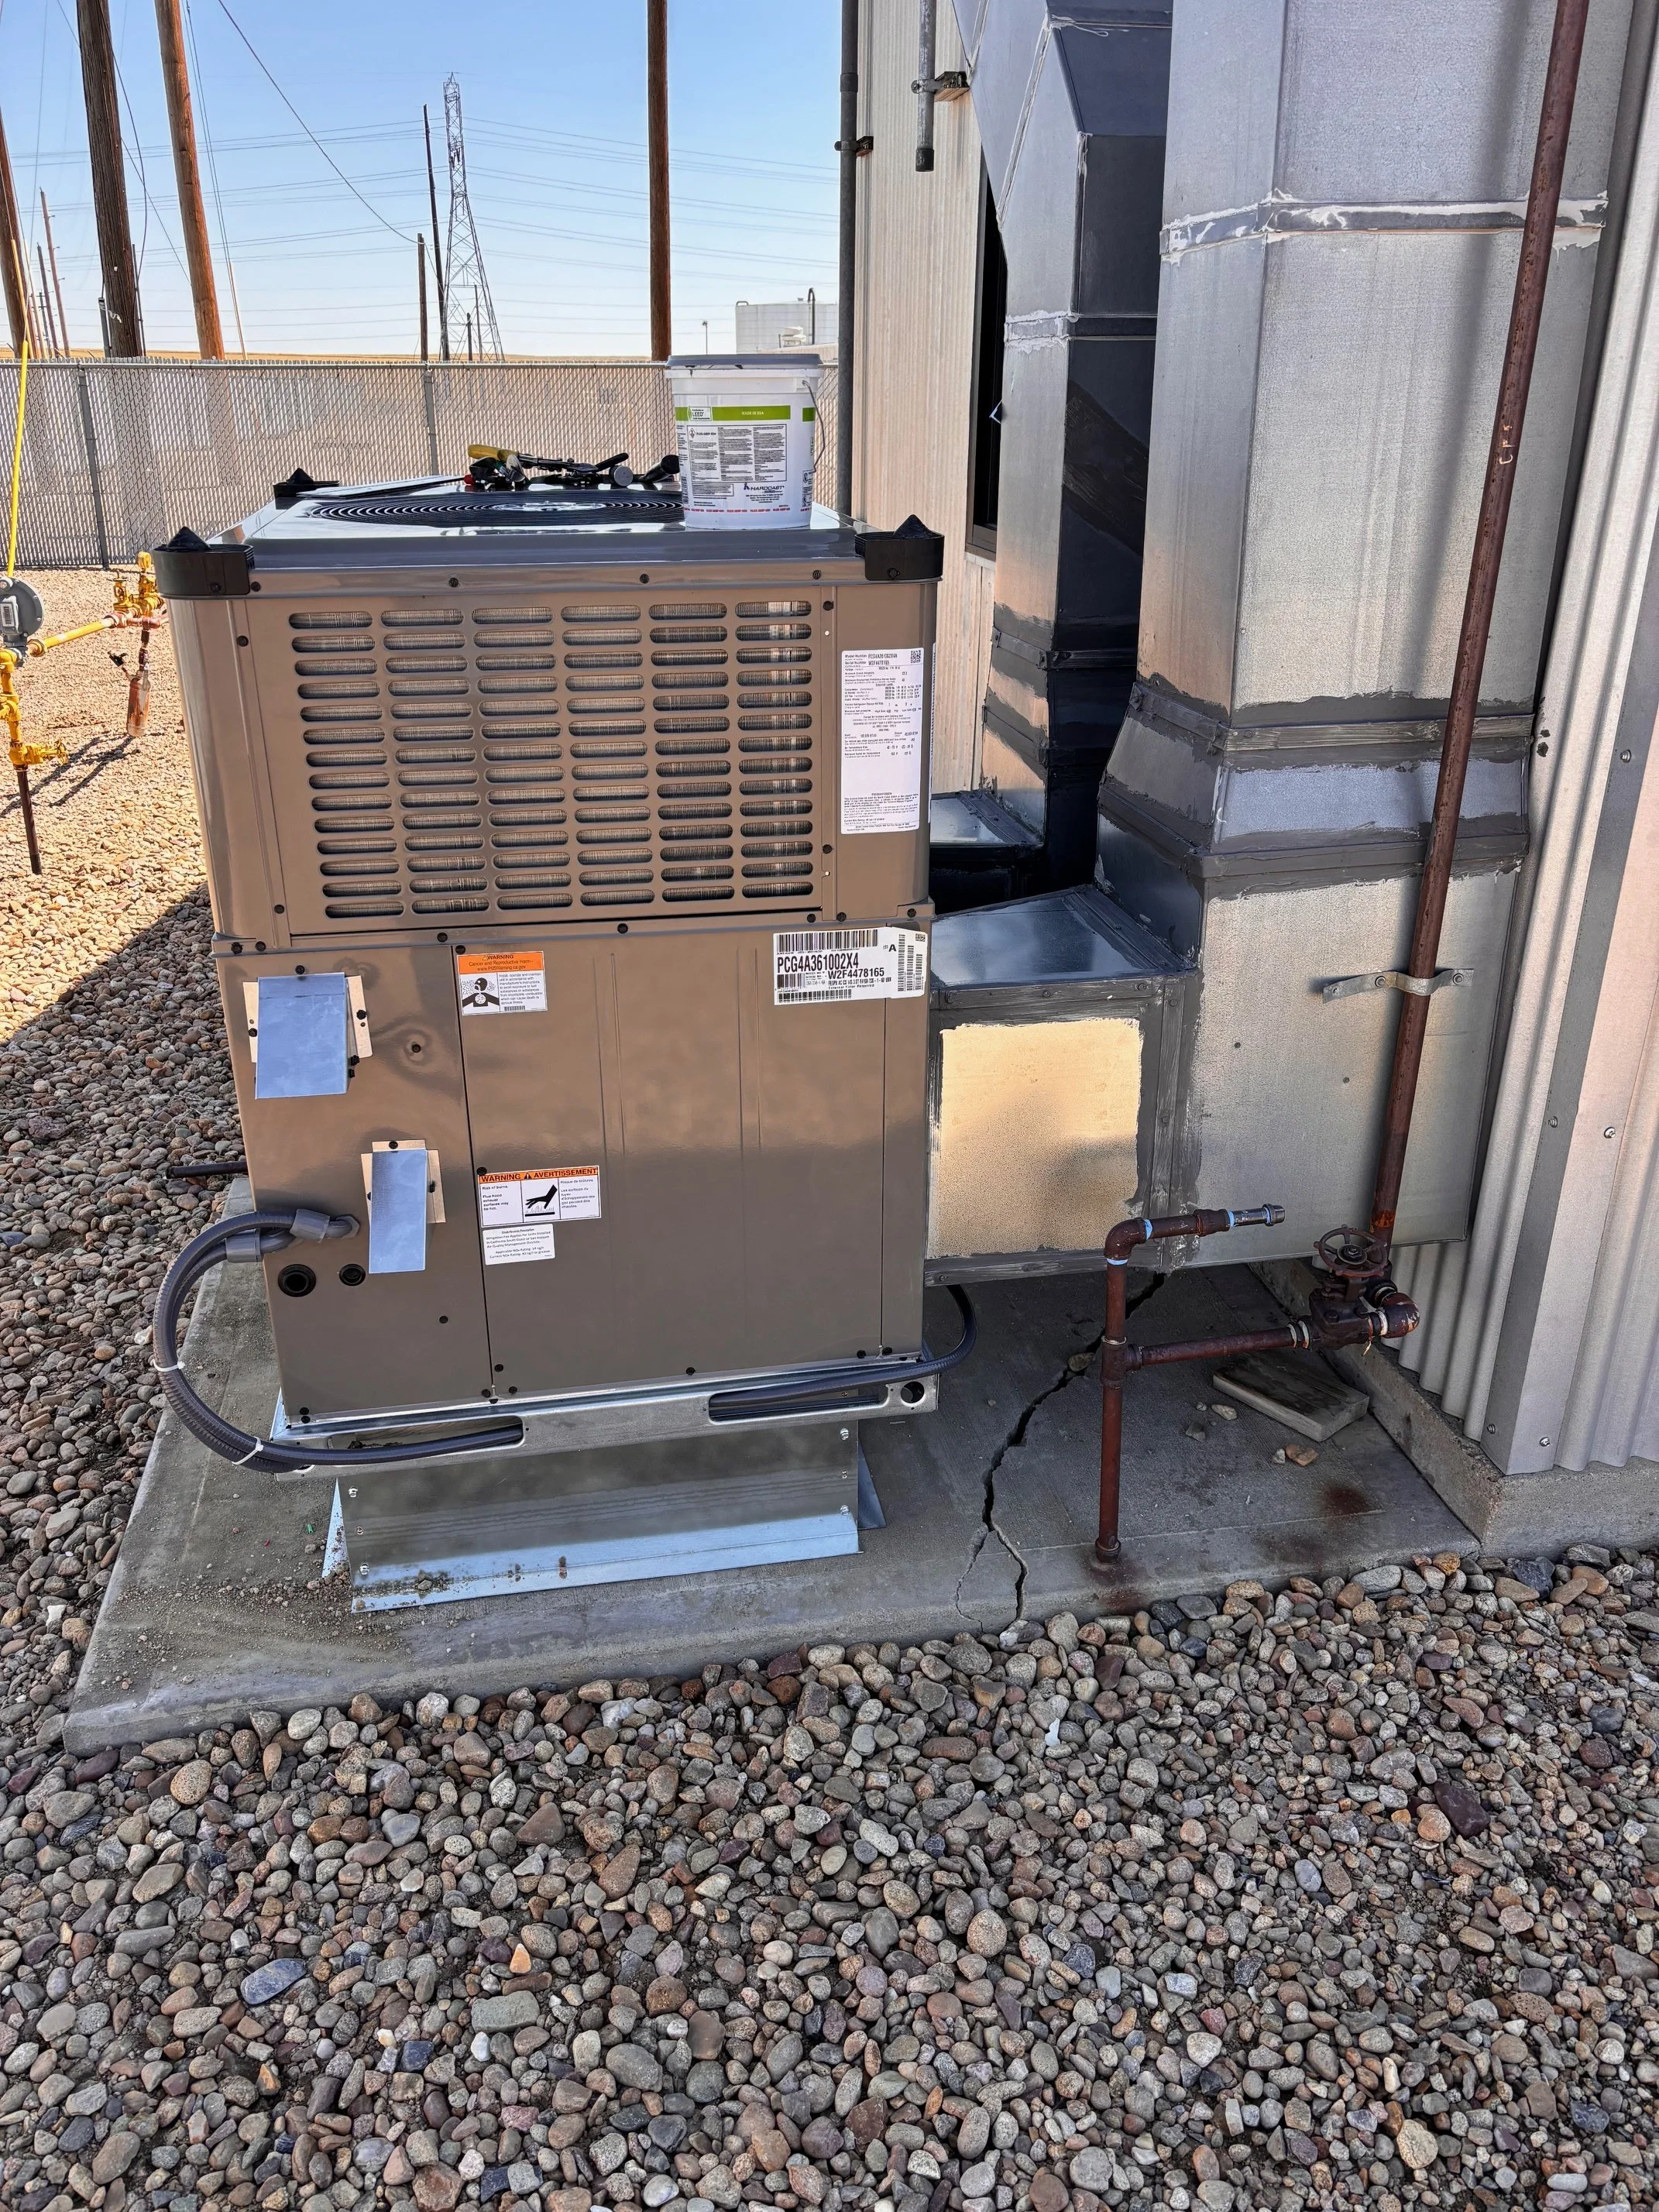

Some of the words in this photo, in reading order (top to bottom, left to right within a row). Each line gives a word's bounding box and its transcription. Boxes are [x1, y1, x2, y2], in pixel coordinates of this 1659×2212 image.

[778, 953, 858, 973] PCG4A361002X4
[828, 967, 884, 979] W2F4478165
[482, 1173, 520, 1182] WARNING
[534, 1168, 596, 1177] AVERTISSEMENT
